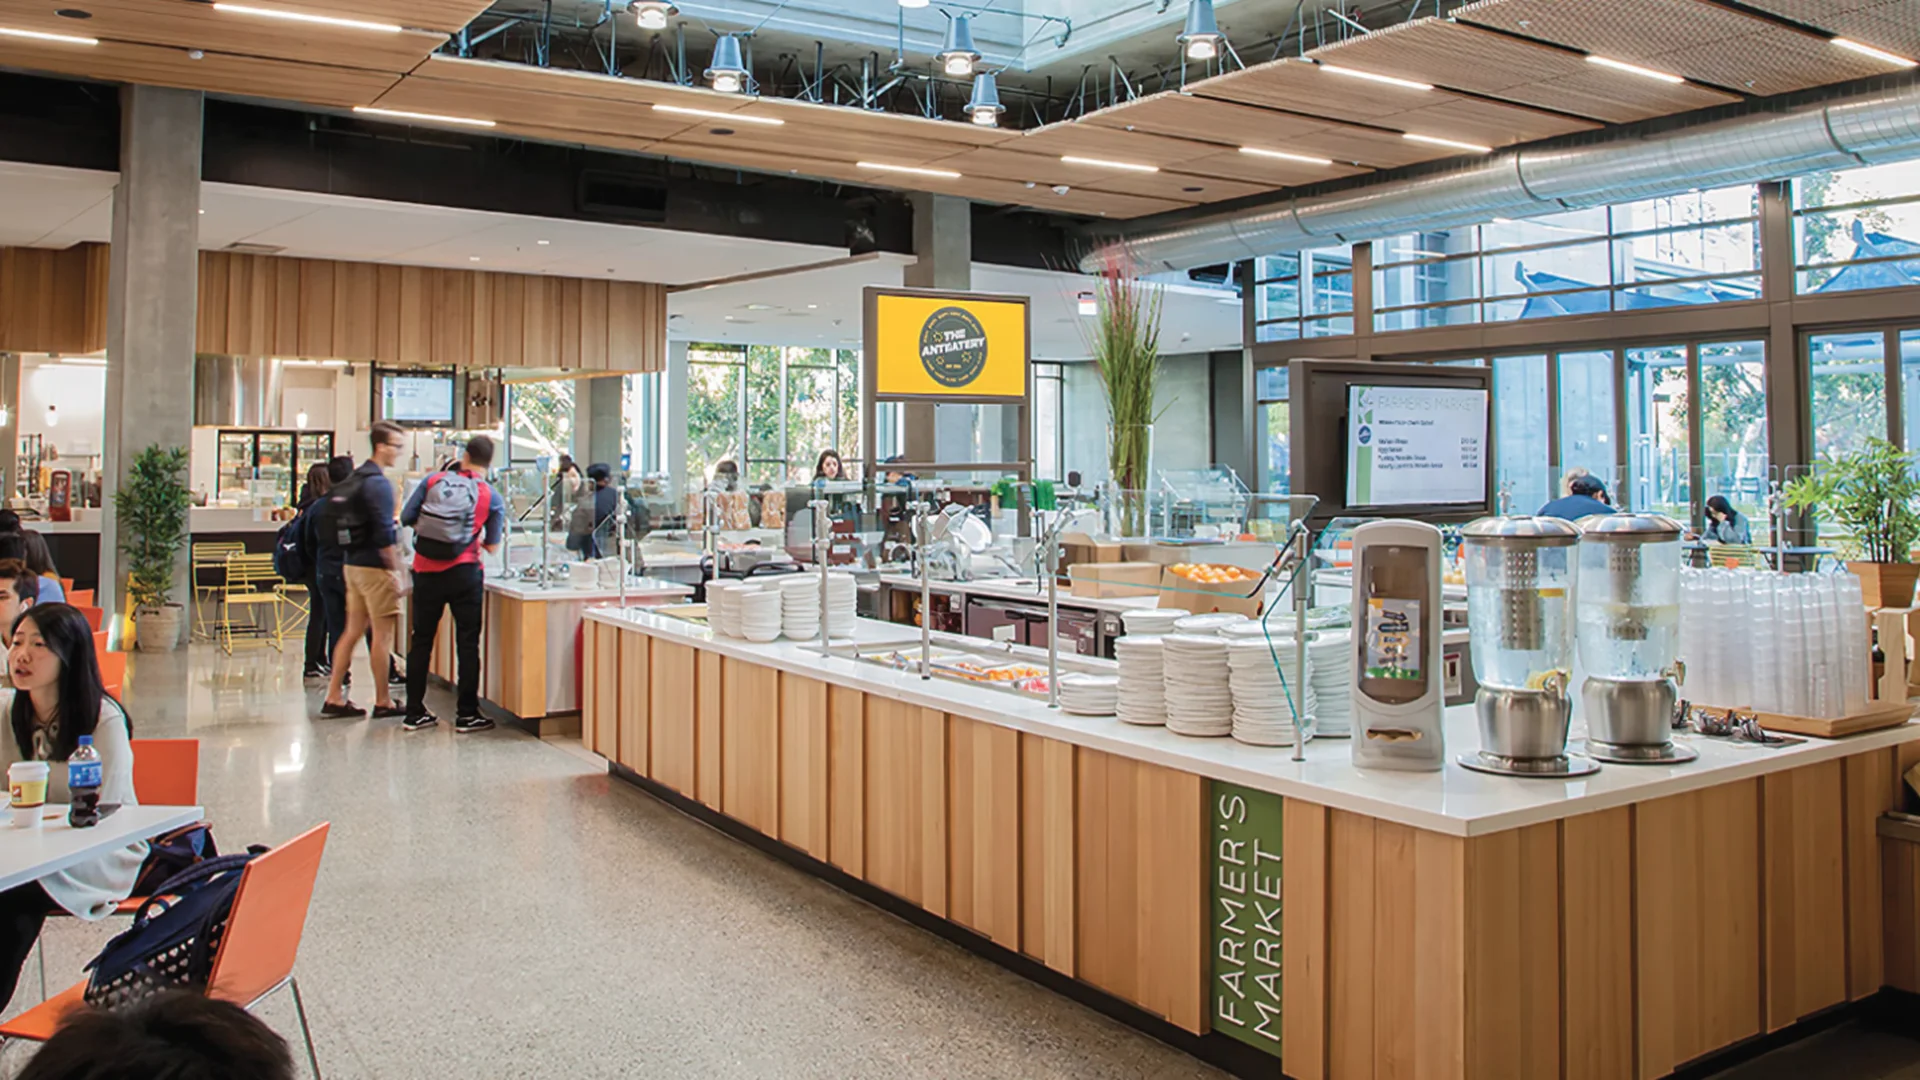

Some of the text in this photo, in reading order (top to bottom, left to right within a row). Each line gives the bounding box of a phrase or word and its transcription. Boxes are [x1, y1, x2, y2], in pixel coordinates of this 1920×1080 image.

[944, 328, 966, 342] THE
[921, 337, 986, 357] ANTEATERY
[1434, 396, 1479, 411] MARKET
[1218, 794, 1246, 1026] FARMER'S
[1253, 838, 1281, 1042] MARKET
